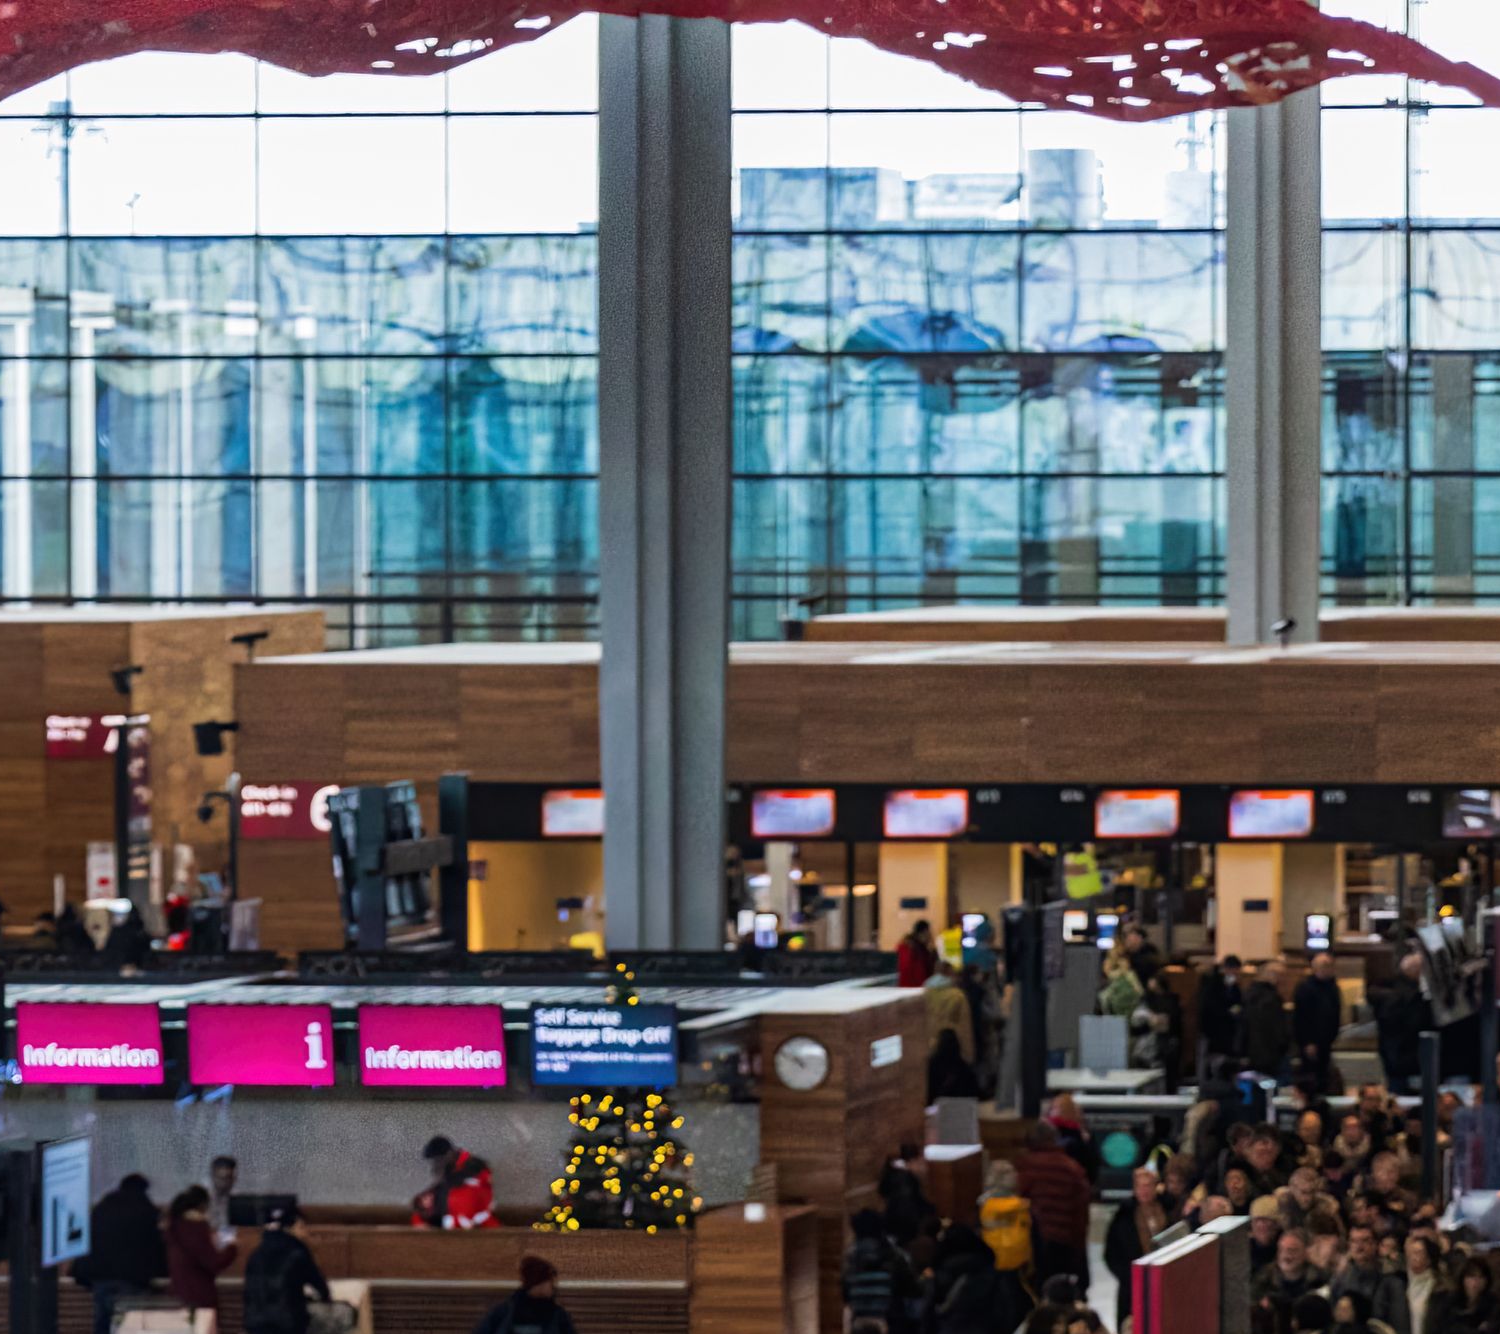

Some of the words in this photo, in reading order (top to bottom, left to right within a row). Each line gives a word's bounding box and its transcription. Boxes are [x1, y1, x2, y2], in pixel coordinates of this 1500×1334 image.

[535, 1008, 566, 1026] Self
[566, 1008, 622, 1027] Service
[304, 1021, 328, 1068] i
[535, 1026, 600, 1047] Baggage
[23, 1042, 159, 1068] Information
[365, 1045, 502, 1069] Information
